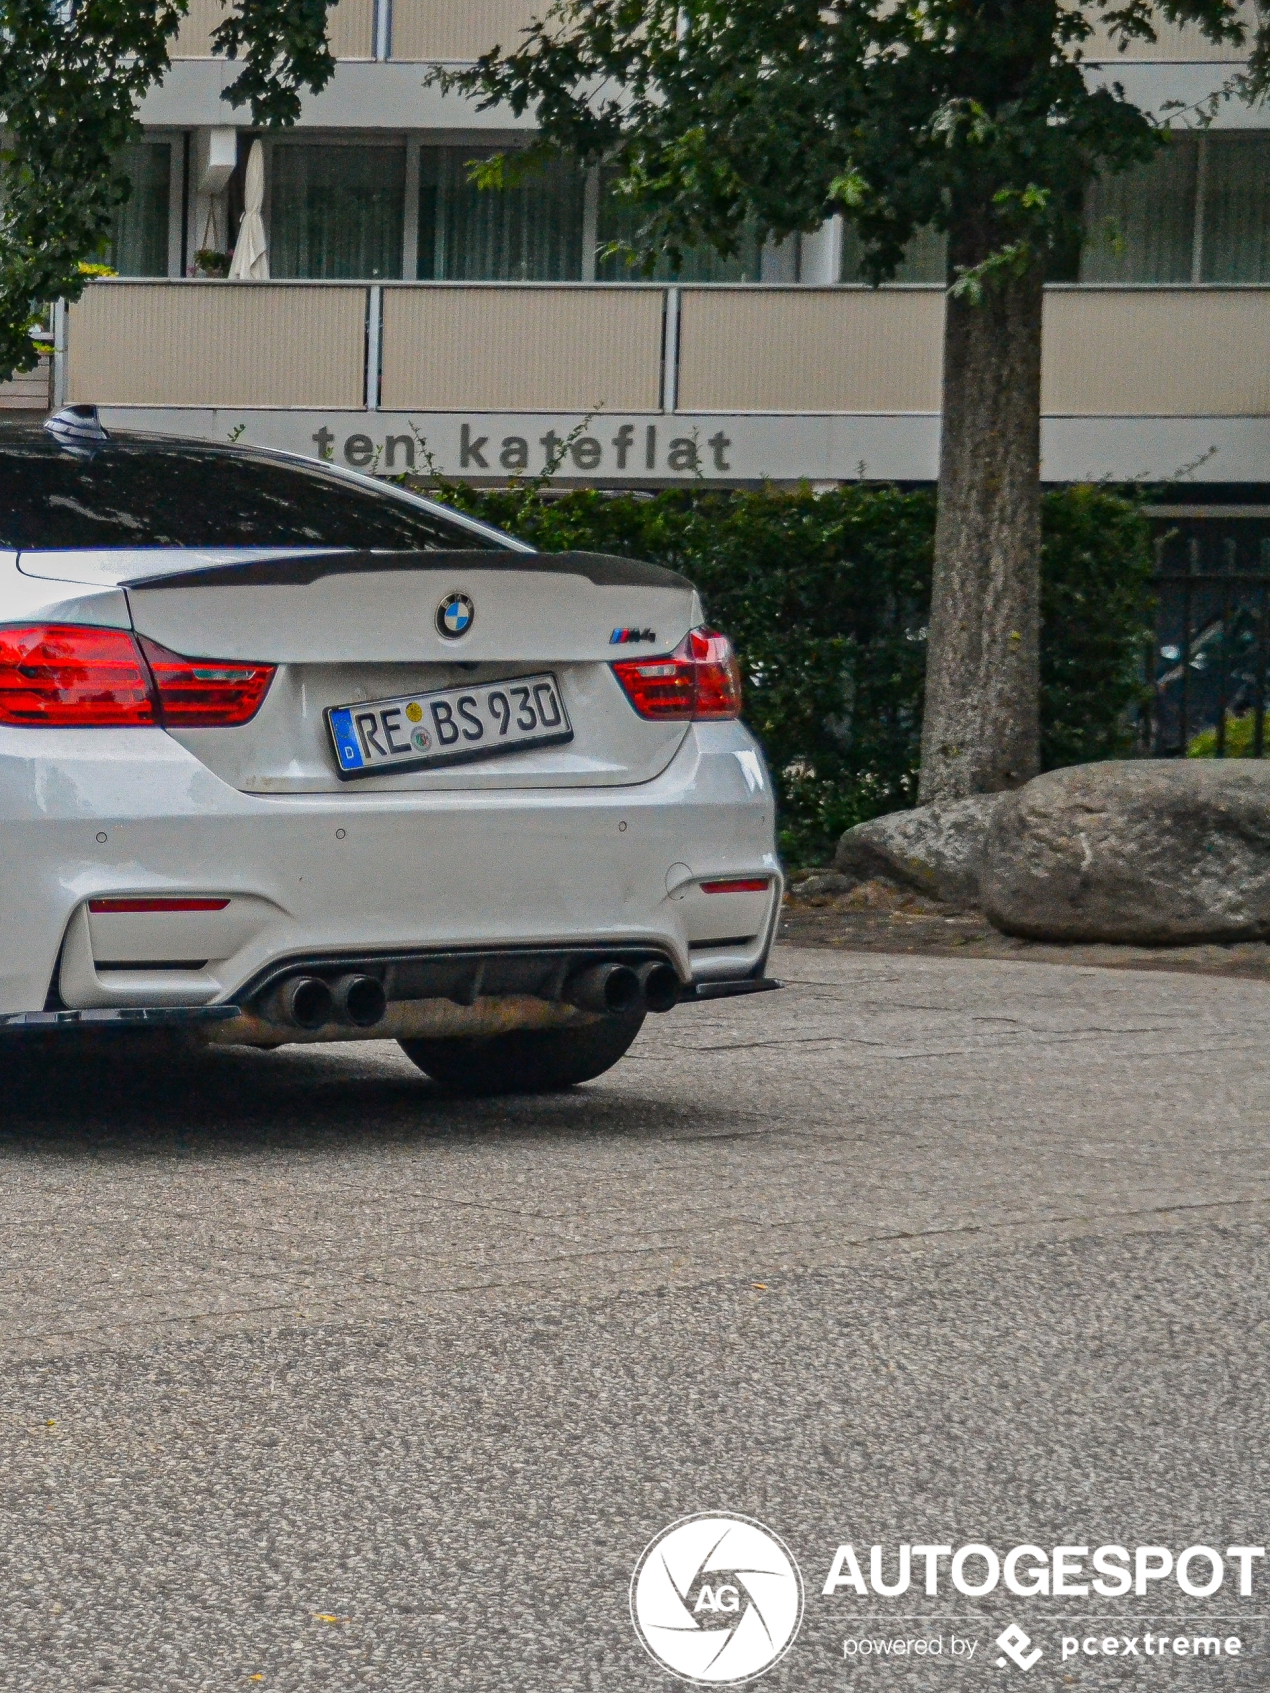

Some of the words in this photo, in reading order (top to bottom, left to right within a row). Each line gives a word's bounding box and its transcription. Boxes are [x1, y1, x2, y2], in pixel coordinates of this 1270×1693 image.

[312, 426, 416, 468] ten
[460, 423, 731, 472] kateflat
[344, 747, 354, 759] D
[355, 708, 412, 758] RE
[430, 696, 484, 746] BS
[487, 683, 562, 736] 930
